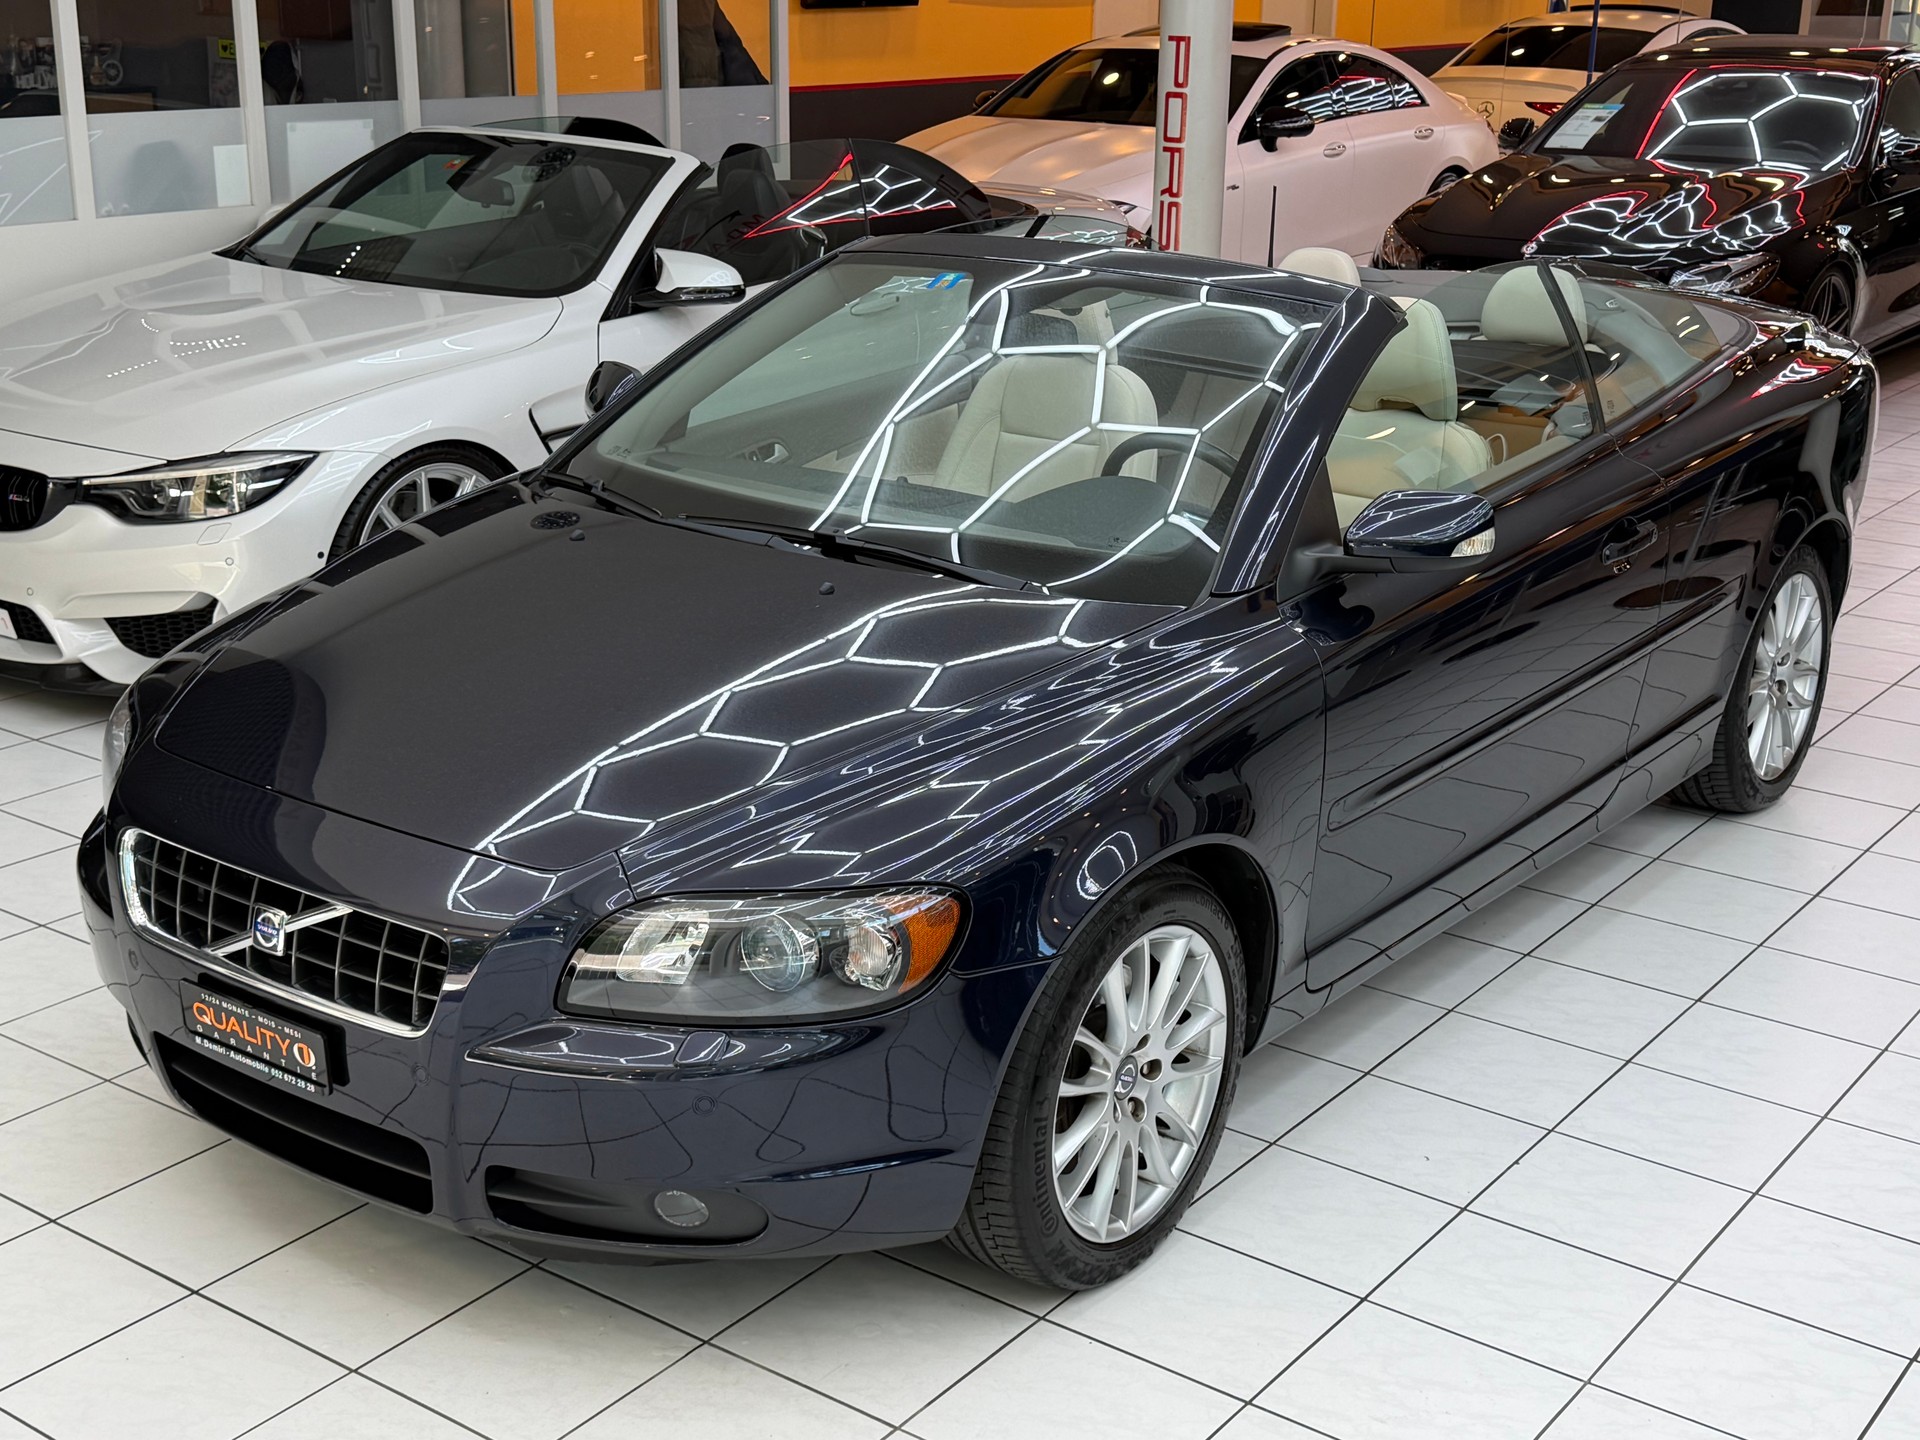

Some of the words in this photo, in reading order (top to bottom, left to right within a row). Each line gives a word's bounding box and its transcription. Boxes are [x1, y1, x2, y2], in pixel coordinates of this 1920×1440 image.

[257, 923, 278, 935] VOLVO
[193, 1001, 291, 1057] QUALITY
[201, 993, 220, 1005] 12/24
[221, 1001, 250, 1018] MONATE
[257, 1015, 276, 1028] MOIS
[283, 1026, 302, 1039] MESI
[195, 1035, 226, 1055] M.Demiri
[229, 1050, 269, 1073] Automobile
[270, 1067, 283, 1079] 052
[283, 1073, 296, 1085] 672
[296, 1078, 306, 1089] 28
[306, 1082, 316, 1093] 28
[196, 1024, 318, 1081] GARANTIE
[1032, 1115, 1058, 1238] Continental
